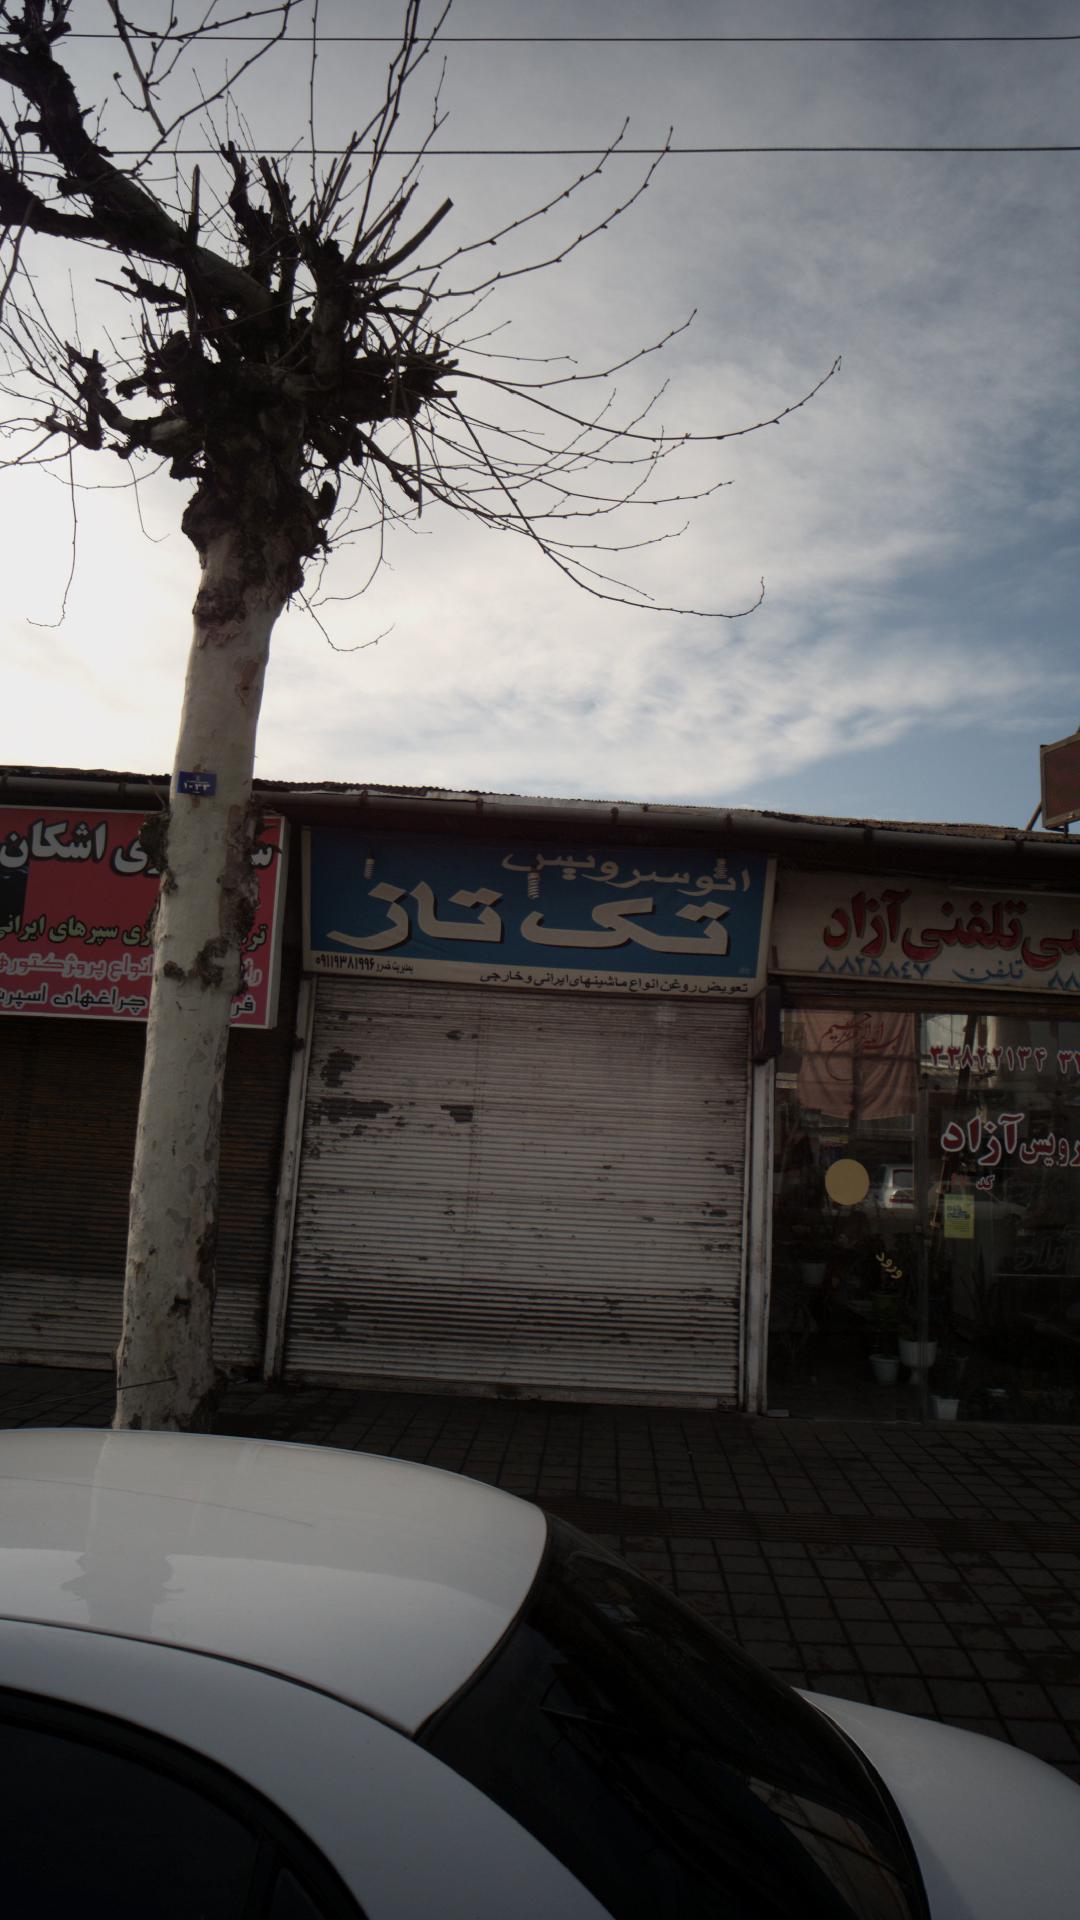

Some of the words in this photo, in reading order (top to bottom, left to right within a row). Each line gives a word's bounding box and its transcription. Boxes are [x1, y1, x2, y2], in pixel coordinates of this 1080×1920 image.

[0, 819, 107, 869] اشکان
[325, 880, 505, 951] تاز
[520, 897, 731, 955] تک
[822, 888, 912, 959] آزاد
[902, 899, 1027, 963] تلفنی
[480, 970, 524, 982] خارجی
[533, 972, 569, 987] ایرانی
[629, 978, 659, 992] انواع
[660, 978, 697, 993] روغن
[698, 981, 749, 994] تعویض
[952, 960, 1024, 983] تلفن
[940, 1112, 1025, 1167] آزاد
[1019, 1131, 1080, 1167] رویس
